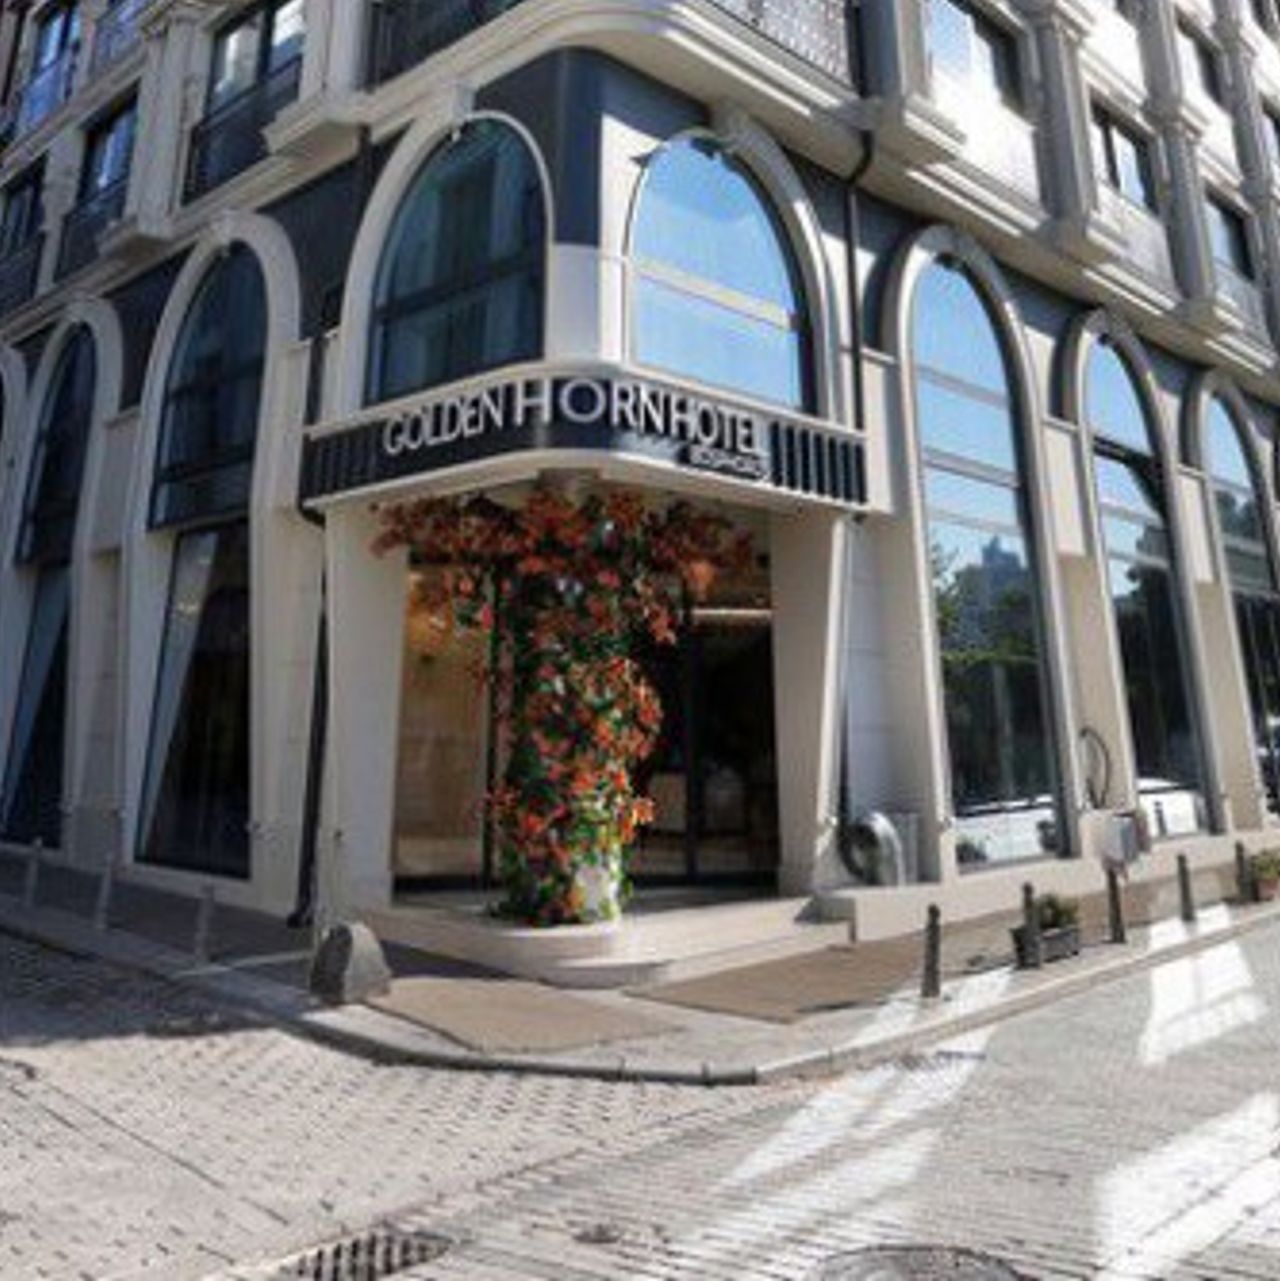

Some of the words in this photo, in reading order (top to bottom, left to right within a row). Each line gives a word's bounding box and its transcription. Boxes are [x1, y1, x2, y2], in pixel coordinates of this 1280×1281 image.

[383, 382, 503, 455] GOLDEN
[516, 376, 665, 435] HORN
[670, 390, 770, 457] HOTEL
